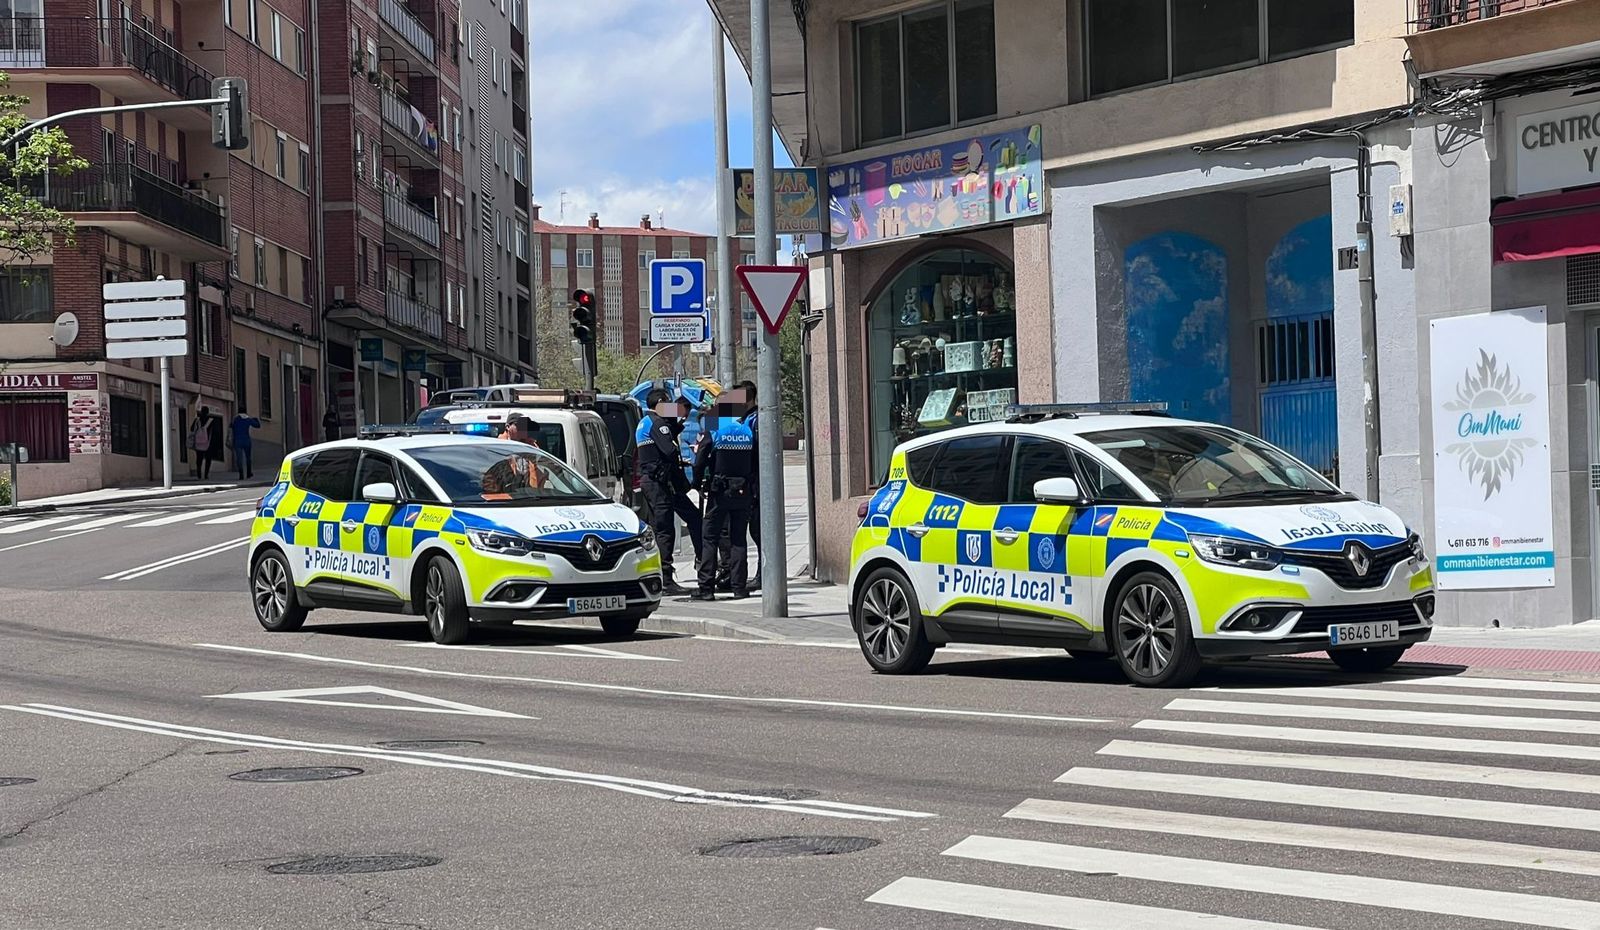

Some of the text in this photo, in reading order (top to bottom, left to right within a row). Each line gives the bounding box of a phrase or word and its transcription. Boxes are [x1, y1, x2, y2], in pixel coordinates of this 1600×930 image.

[892, 150, 942, 177] HOGAR
[1583, 146, 1598, 172] Y
[661, 266, 694, 309] P
[47, 375, 61, 387] II
[721, 434, 750, 442] POLICÍA
[892, 467, 904, 478] 709
[305, 501, 321, 514] 112
[934, 505, 960, 520] 112
[1117, 517, 1152, 530] Policía
[1454, 539, 1464, 547] 611
[1466, 538, 1476, 547] 613
[1478, 538, 1489, 546] 716
[315, 550, 379, 576] Policía Local
[1443, 556, 1546, 568] ommanibienestar.com
[953, 568, 1054, 602] Policía Local
[577, 597, 624, 610] 5645 LPL
[1339, 624, 1396, 641] 5646 LPL
